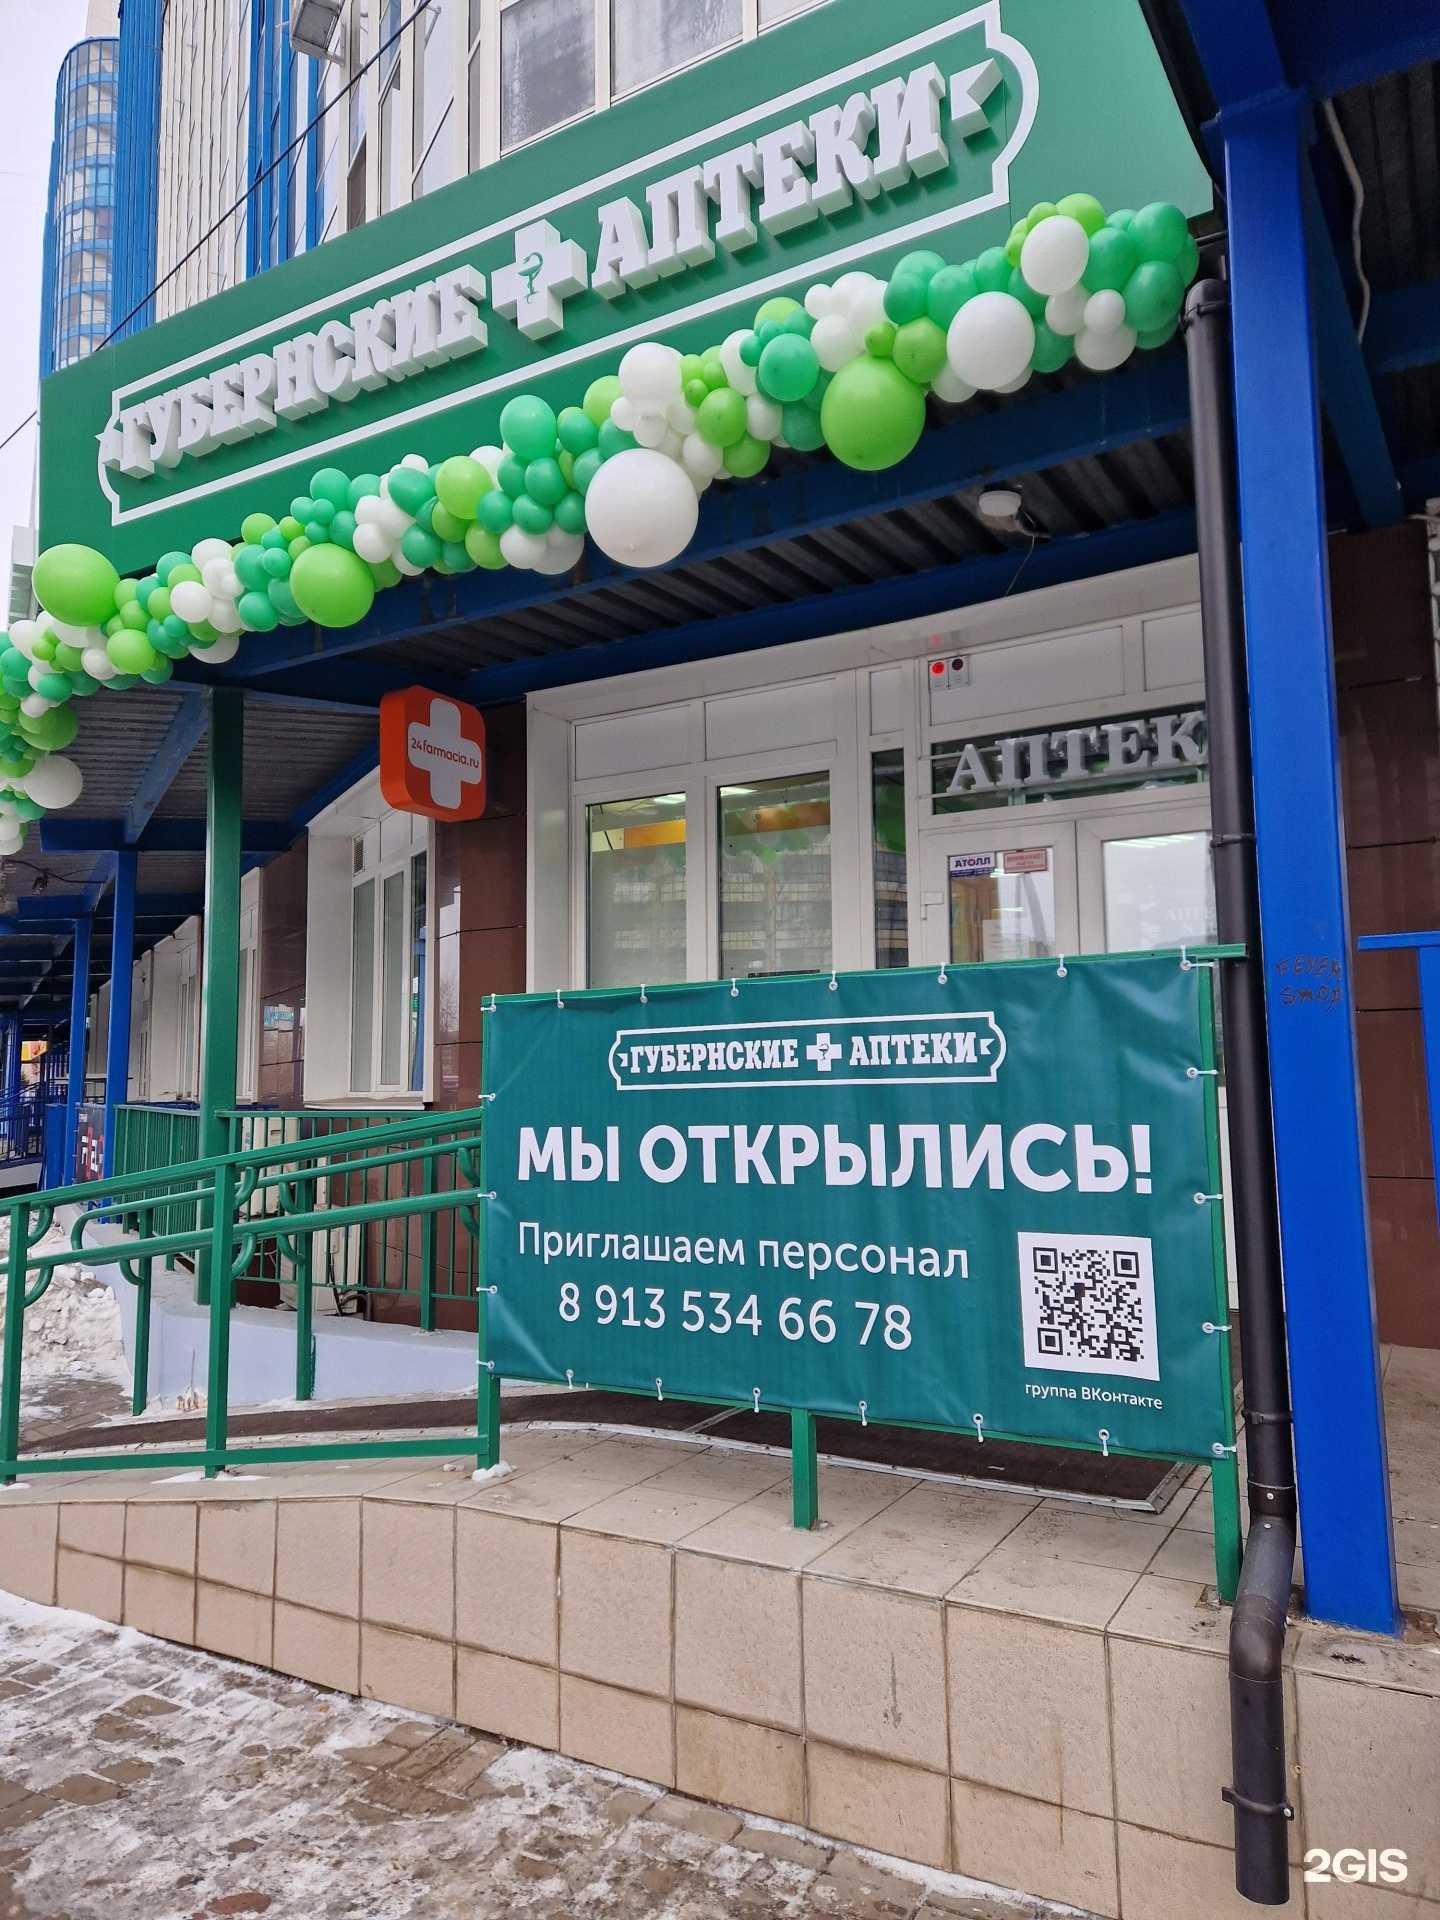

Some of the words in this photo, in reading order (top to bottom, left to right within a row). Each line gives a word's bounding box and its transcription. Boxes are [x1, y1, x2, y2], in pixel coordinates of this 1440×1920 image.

[119, 264, 488, 479] ГУБЕРНСКИЕ
[591, 61, 949, 300] АПТЕКИ
[411, 737, 480, 769] 24farmacia.ru
[954, 856, 991, 868] АТОЛЛ
[631, 1039, 798, 1073] ГУБЕРНСКИЕ
[850, 1032, 977, 1065] АПТЕКИ
[519, 1127, 619, 1181] МЫ
[640, 1124, 1151, 1193] ОТКРЫЛИСЬ!
[520, 1222, 744, 1264] Приглашаем
[760, 1241, 968, 1279] персонал
[560, 1283, 579, 1321] 8
[596, 1285, 665, 1328] 913
[683, 1291, 761, 1335] 534
[779, 1298, 836, 1343] 66
[855, 1302, 911, 1350] 78
[1026, 1384, 1076, 1399] группа
[1082, 1387, 1162, 1409] ВКонтакте
